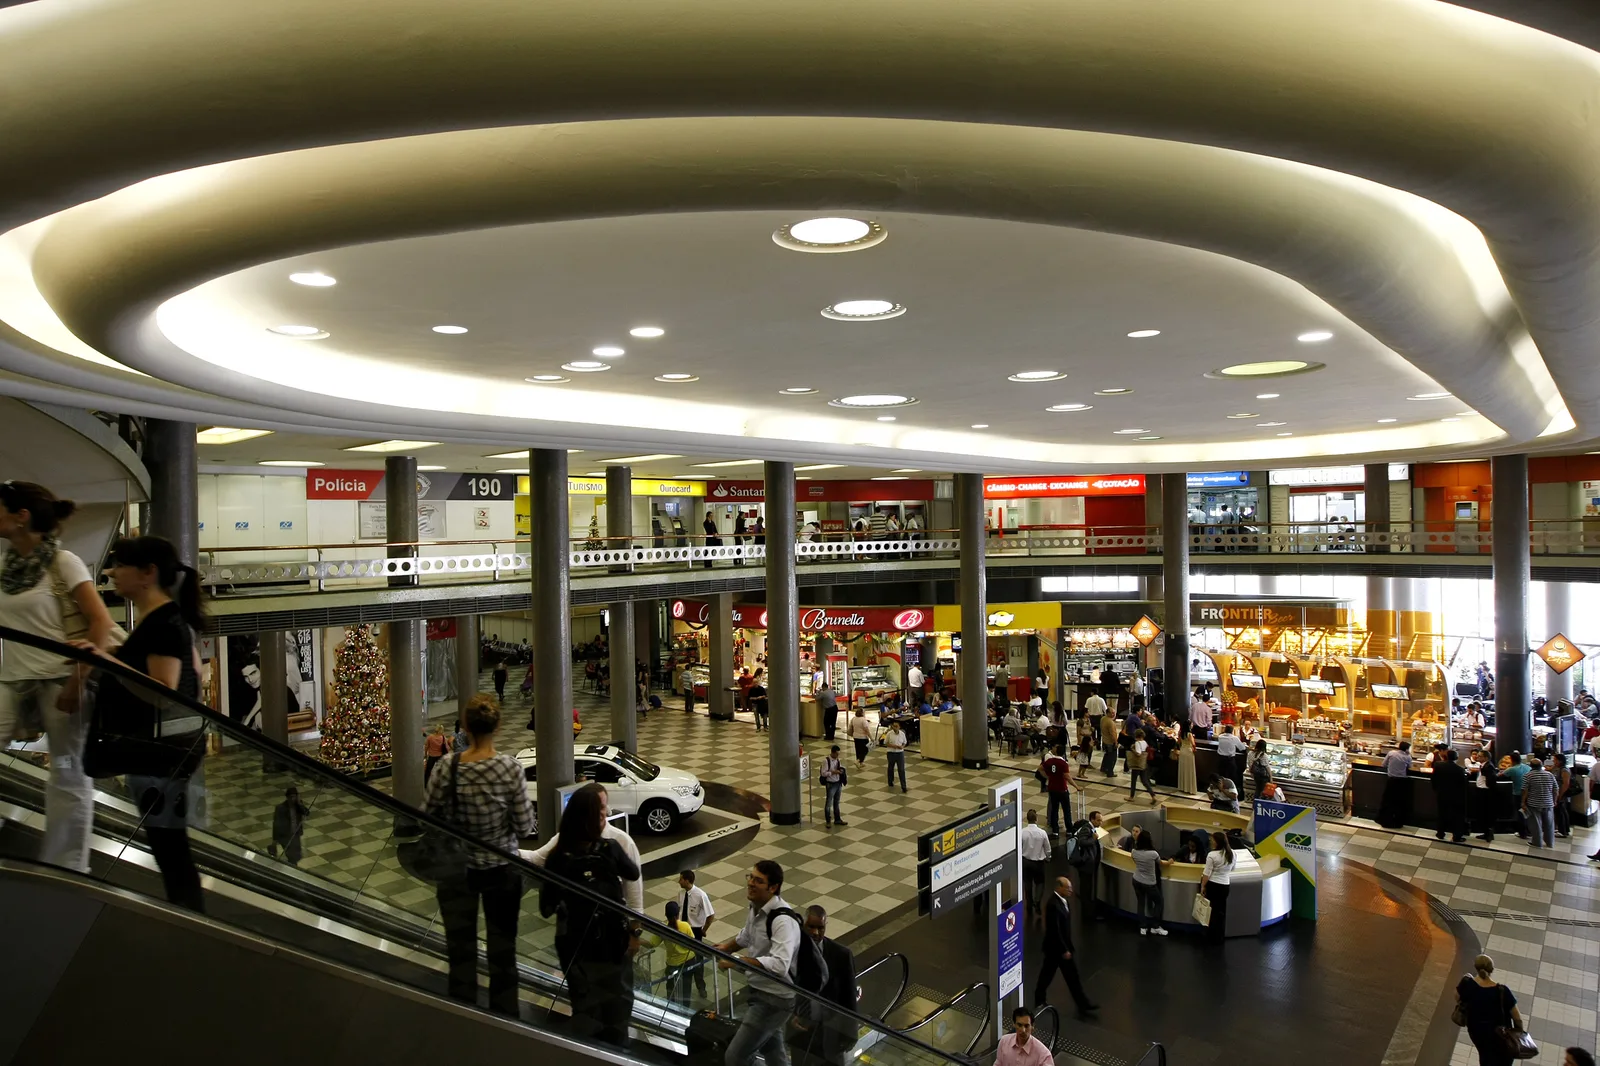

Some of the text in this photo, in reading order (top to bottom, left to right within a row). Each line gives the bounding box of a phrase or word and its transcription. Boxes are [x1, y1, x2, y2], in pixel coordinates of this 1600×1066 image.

[315, 478, 367, 492] Polícia
[468, 478, 501, 496] 190
[659, 483, 691, 493] Ourocard
[802, 608, 865, 630] Brunella
[1201, 608, 1272, 620] FRONTIER
[298, 629, 310, 637] 212
[298, 636, 311, 644] VIP
[1051, 764, 1057, 773] 8
[708, 825, 739, 838] CR-V
[956, 824, 979, 840] Embarque
[980, 816, 997, 828] Portões
[1285, 844, 1312, 852] INFRAERO
[954, 850, 980, 866] Restaurante
[955, 864, 1003, 894] Administração INFRAERO
